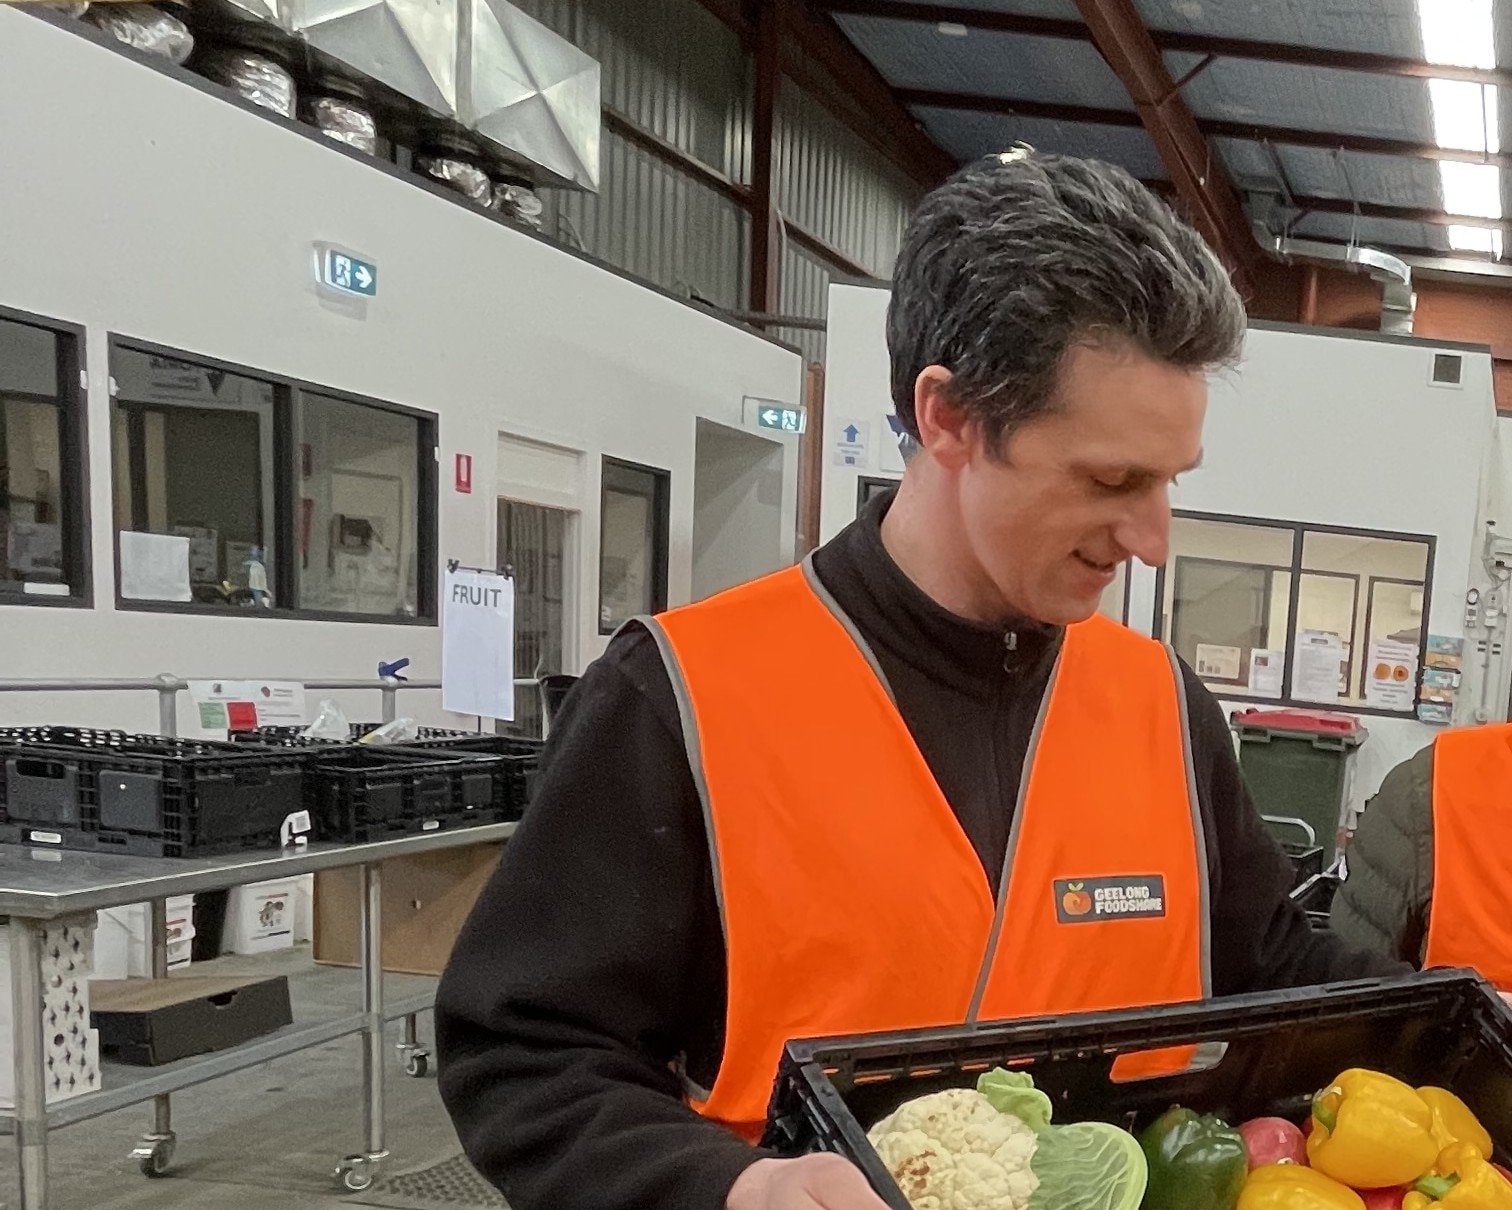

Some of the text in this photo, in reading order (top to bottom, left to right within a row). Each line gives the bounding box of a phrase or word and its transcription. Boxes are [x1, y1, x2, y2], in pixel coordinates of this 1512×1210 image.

[452, 583, 502, 608] FRUIT
[1094, 886, 1150, 901] GEELONG
[1095, 897, 1163, 914] FOODSHARE
